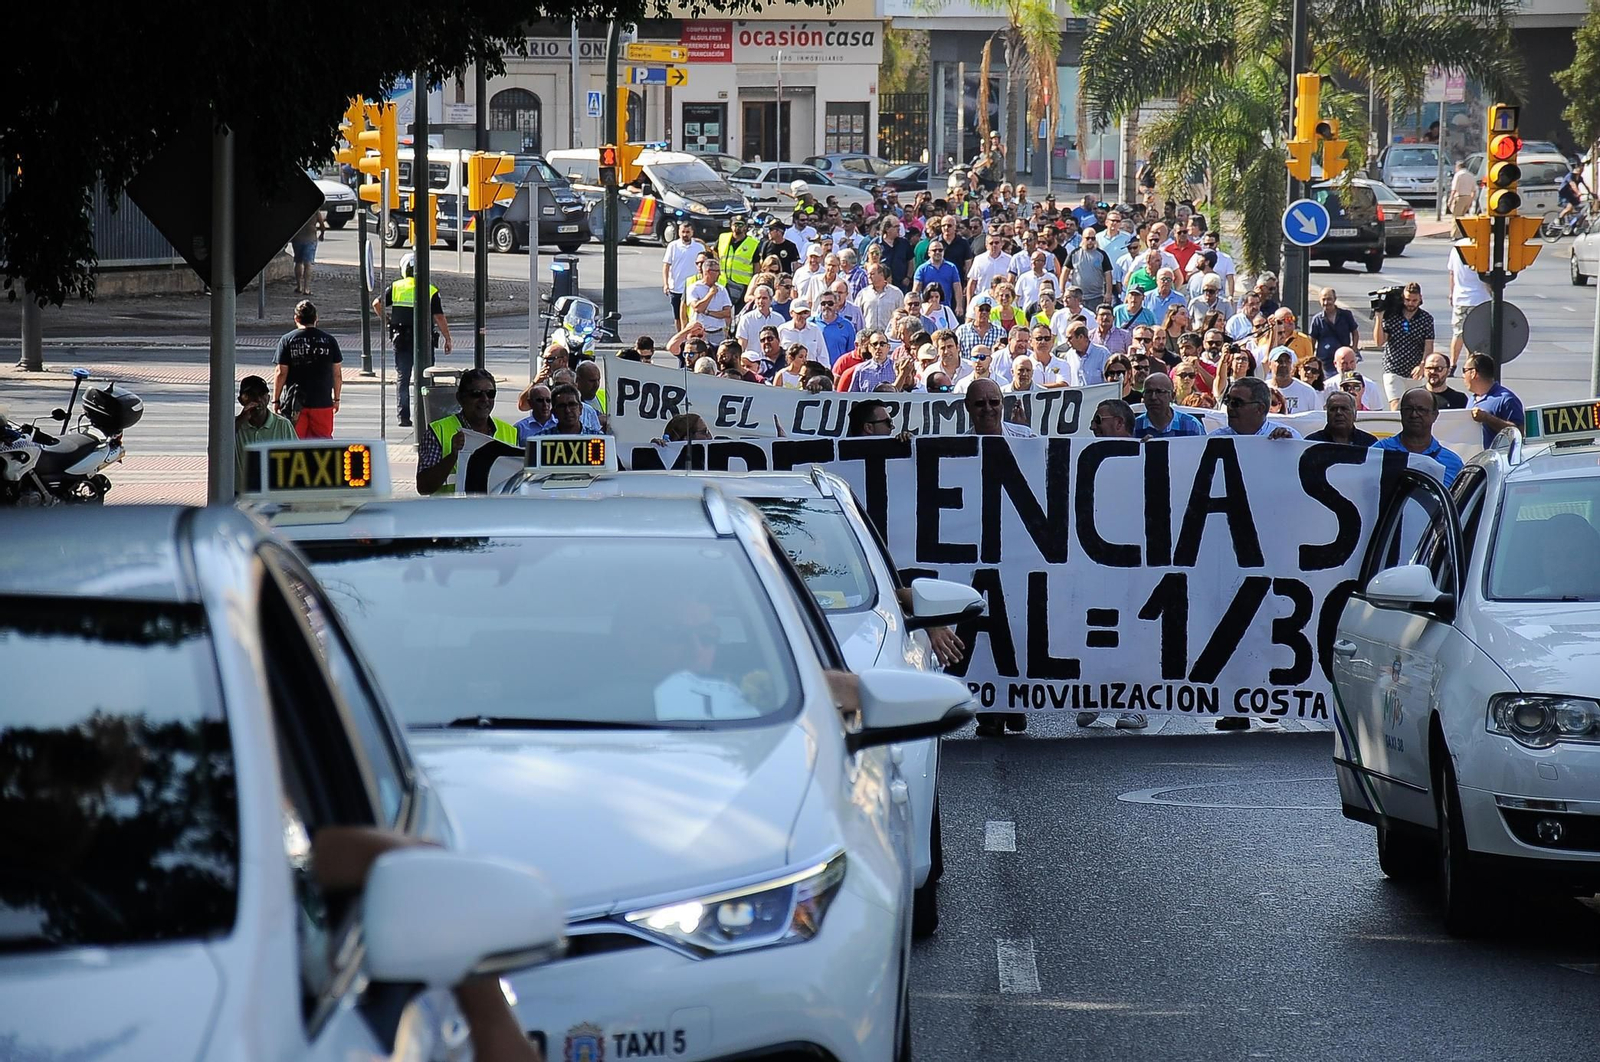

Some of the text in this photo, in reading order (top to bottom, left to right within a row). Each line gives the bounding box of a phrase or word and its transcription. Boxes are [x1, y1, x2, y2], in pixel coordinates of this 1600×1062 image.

[616, 376, 1083, 437] POR EL CULIMNTO
[1543, 405, 1594, 433] TAXI
[269, 450, 342, 488] TAXI
[542, 441, 587, 465] TAXI
[1008, 682, 1219, 714] MOVILIZACION
[1234, 687, 1329, 720] COSTA
[613, 1030, 686, 1058] TAXI 5
